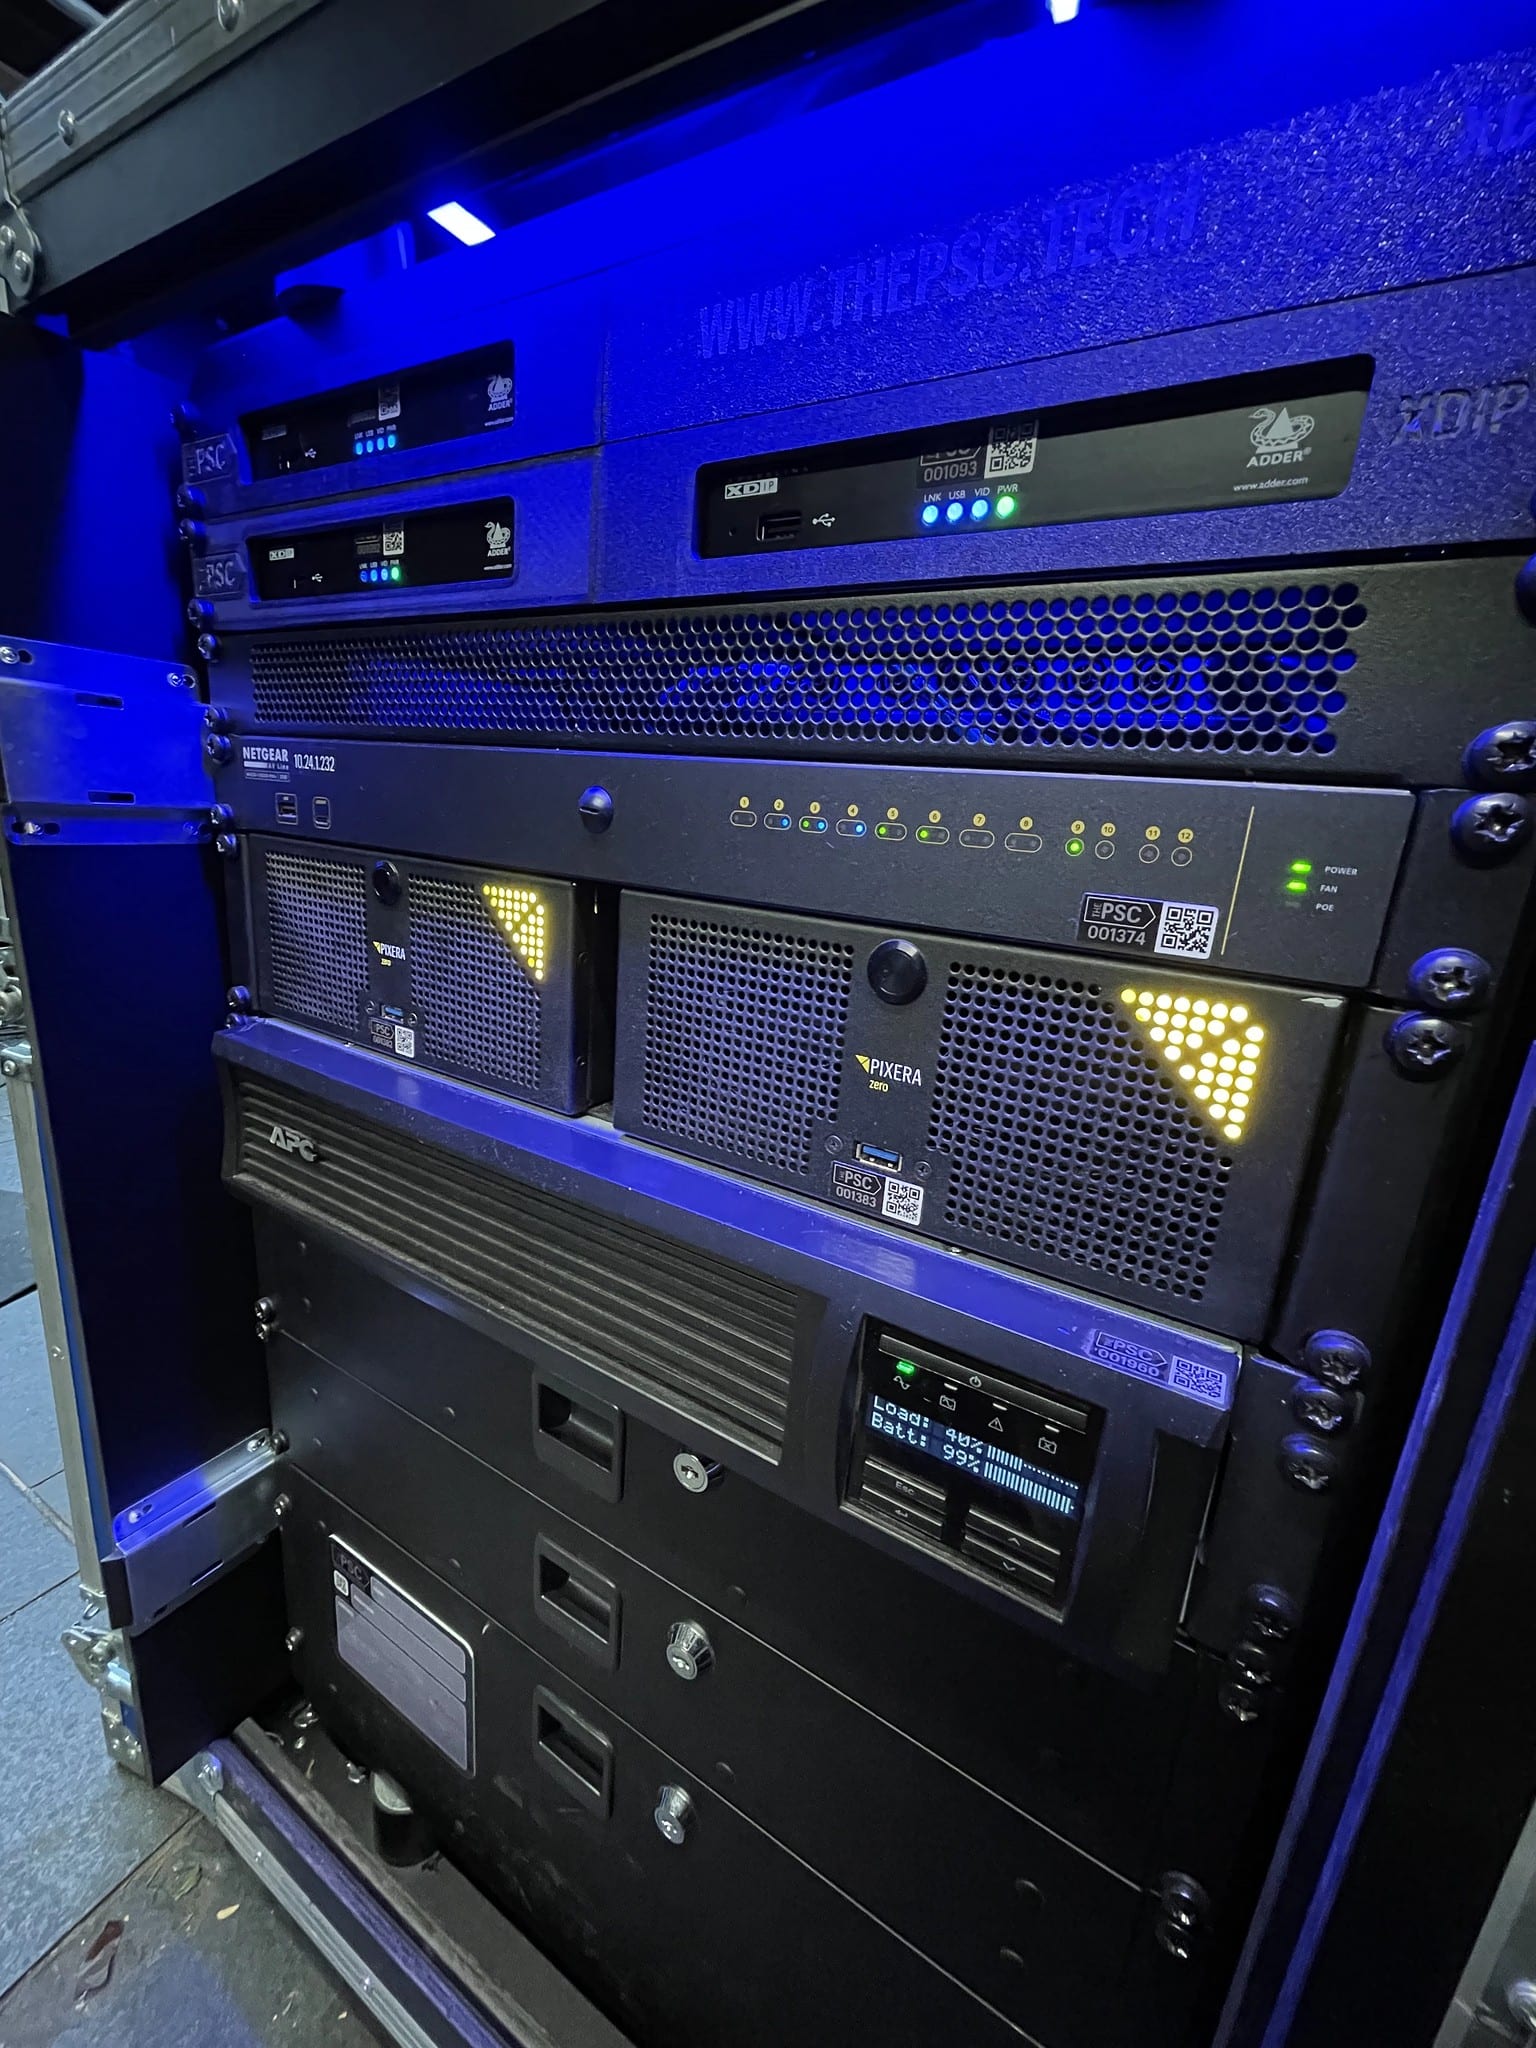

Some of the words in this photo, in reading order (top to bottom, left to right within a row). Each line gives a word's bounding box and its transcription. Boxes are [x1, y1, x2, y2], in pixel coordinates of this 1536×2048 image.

[1390, 380, 1531, 446] XDIP
[924, 460, 978, 483] 001093
[924, 493, 942, 503] LNK
[949, 490, 966, 500] USB
[974, 487, 991, 497] VID
[997, 483, 1019, 494] PWR
[1233, 477, 1309, 491] www.adder.com
[243, 746, 289, 762] NETGEAR
[294, 753, 335, 772] 10.24.1.232
[1324, 865, 1358, 876] POWER
[1320, 884, 1338, 893] FAN
[1101, 901, 1143, 923] PSC
[1316, 903, 1335, 912] POE
[1087, 925, 1147, 946] 001374
[380, 942, 406, 961] PIXERA
[375, 1023, 391, 1037] PSC
[870, 1058, 922, 1087] PIXERA
[869, 1079, 889, 1093] zero
[269, 1126, 318, 1162] APC
[844, 1170, 873, 1191] PSC
[836, 1186, 877, 1208] 001383
[1113, 1340, 1154, 1362] PSC
[1098, 1348, 1160, 1377] 001960
[873, 1395, 929, 1428] Load:
[945, 1428, 984, 1454] 40%
[871, 1411, 927, 1447] Batt:
[943, 1444, 981, 1473] 99%
